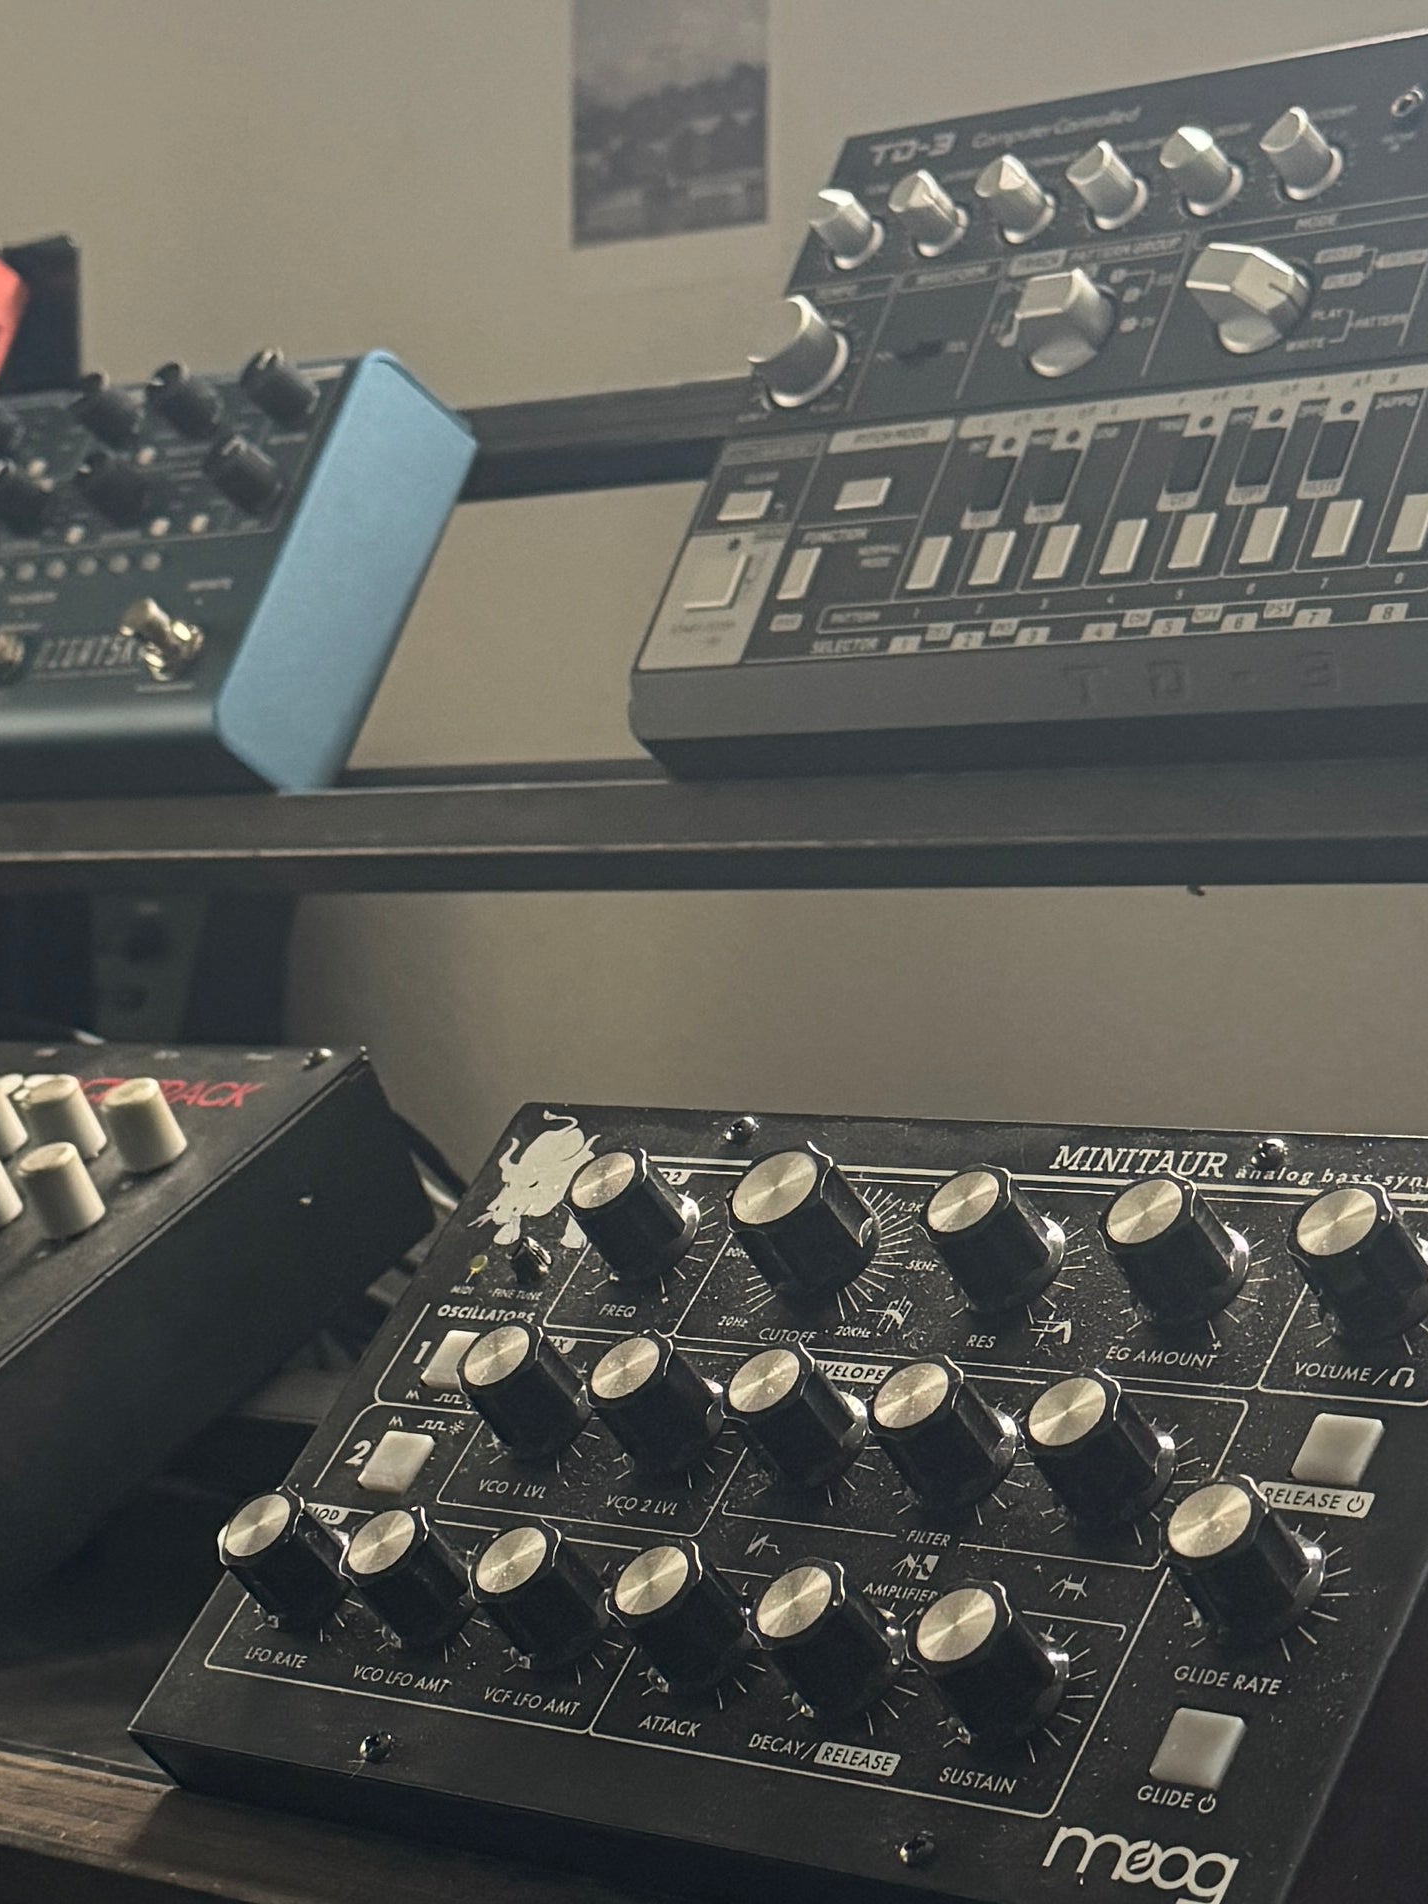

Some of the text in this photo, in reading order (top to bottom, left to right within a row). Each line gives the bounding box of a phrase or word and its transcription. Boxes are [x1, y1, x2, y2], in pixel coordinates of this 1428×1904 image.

[870, 130, 956, 167] TD-3
[1049, 1144, 1230, 1179] MINITAUR
[1234, 1164, 1315, 1186] analog
[1320, 1168, 1373, 1185] bass
[449, 1285, 544, 1302] MIDI FINE TUNE
[436, 1303, 537, 1324] OSCILLATORS
[598, 1303, 637, 1319] FREQ
[717, 1315, 749, 1328] 20Hz
[758, 1327, 818, 1344] CUTOFF
[965, 1333, 997, 1349] RES
[412, 1340, 432, 1365] 1
[1105, 1344, 1219, 1370] EG AMOUNT
[822, 1363, 887, 1383] VELOPE
[345, 1440, 372, 1467] 2
[478, 1477, 510, 1495] VCO
[523, 1484, 547, 1500] LVL
[1262, 1486, 1342, 1511] RELEASE
[606, 1494, 639, 1512] VCO
[653, 1500, 679, 1517] LVL
[906, 1529, 952, 1548] FILTER
[862, 1581, 939, 1603] AMPLIFIER
[244, 1645, 309, 1670] LFO RATE
[352, 1664, 453, 1695] VCO LFO AMT
[1173, 1664, 1283, 1696] GLIDE RATE
[482, 1685, 582, 1717] VCF LFO AMT
[637, 1714, 702, 1738] ATTACK
[820, 1746, 897, 1773] RELEASE
[938, 1766, 1018, 1796] SUSTAIN
[1136, 1784, 1195, 1810] GLIDE
